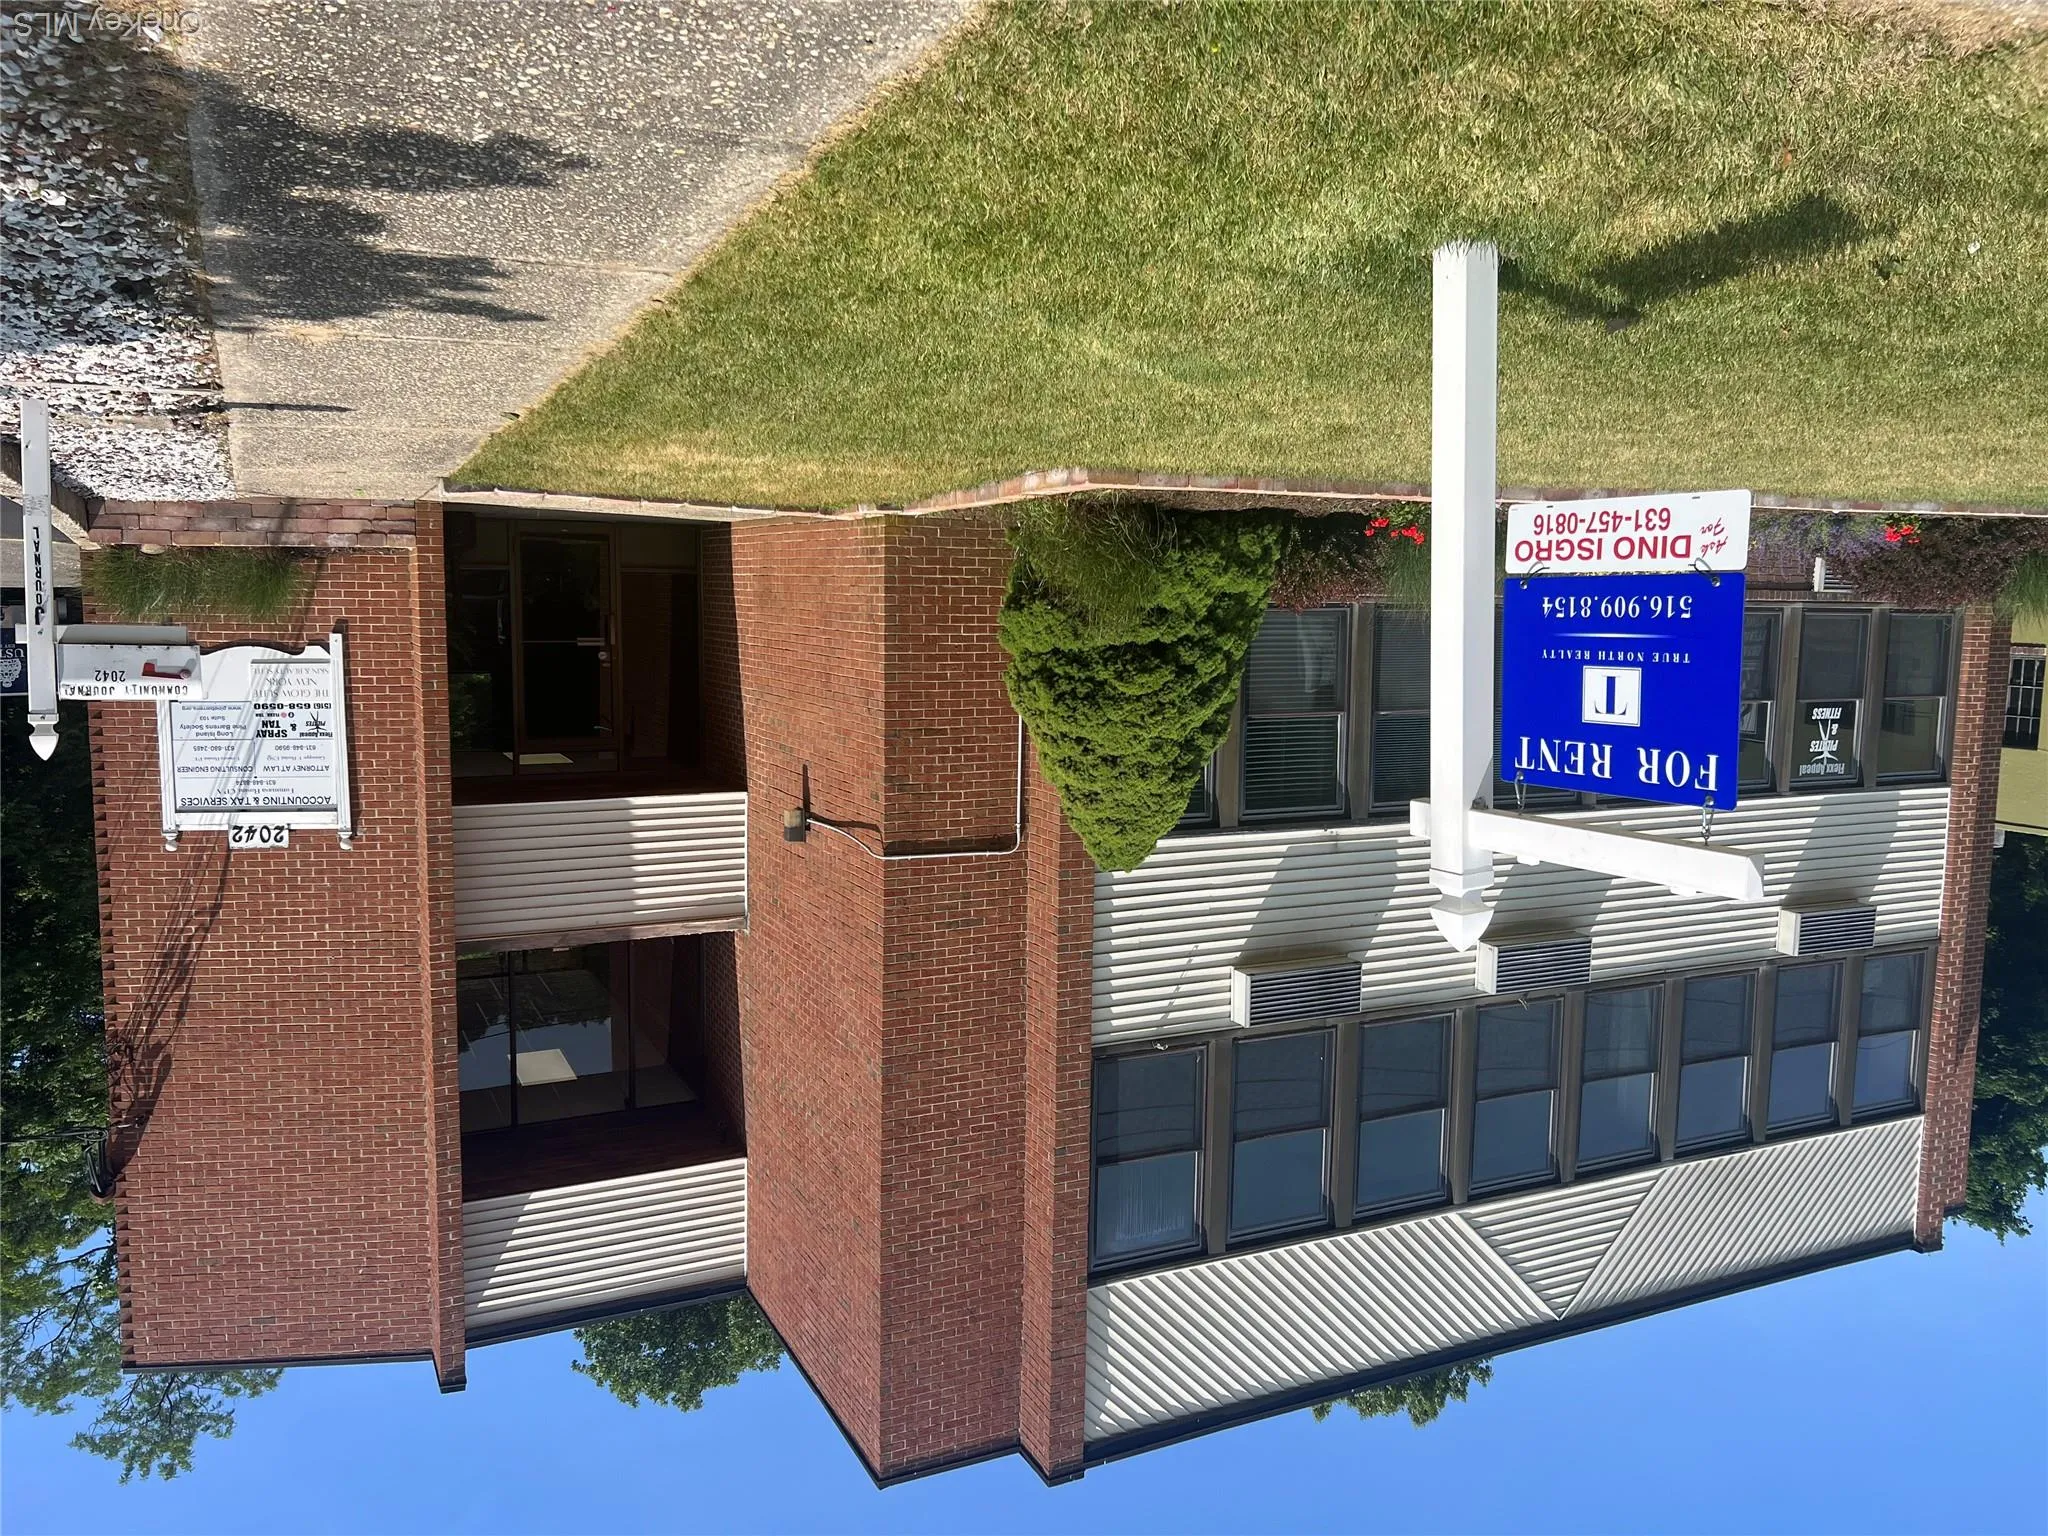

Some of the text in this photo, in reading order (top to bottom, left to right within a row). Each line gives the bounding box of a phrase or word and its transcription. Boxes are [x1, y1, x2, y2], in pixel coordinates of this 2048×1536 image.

[1533, 507, 1671, 536] 631-457-0816
[1700, 517, 1725, 536] For
[1514, 534, 1692, 562] DINO ISGRO
[1700, 536, 1728, 556] Ask
[32, 527, 44, 625] JOURNAL
[1542, 596, 1692, 618] 516.909.8154
[1540, 648, 1690, 664] TRUE NORTH REALTY
[95, 670, 126, 682] 2042
[1594, 675, 1628, 715] T
[1812, 707, 1842, 720] FITNESS
[256, 730, 287, 738] SPRAY
[1831, 724, 1838, 735] &
[1514, 736, 1719, 791] FOR RENT
[1799, 763, 1845, 776] Flexx Appeal
[180, 796, 331, 806] ACCOUNTING & TAX SERVICES
[232, 825, 284, 844] 2042
